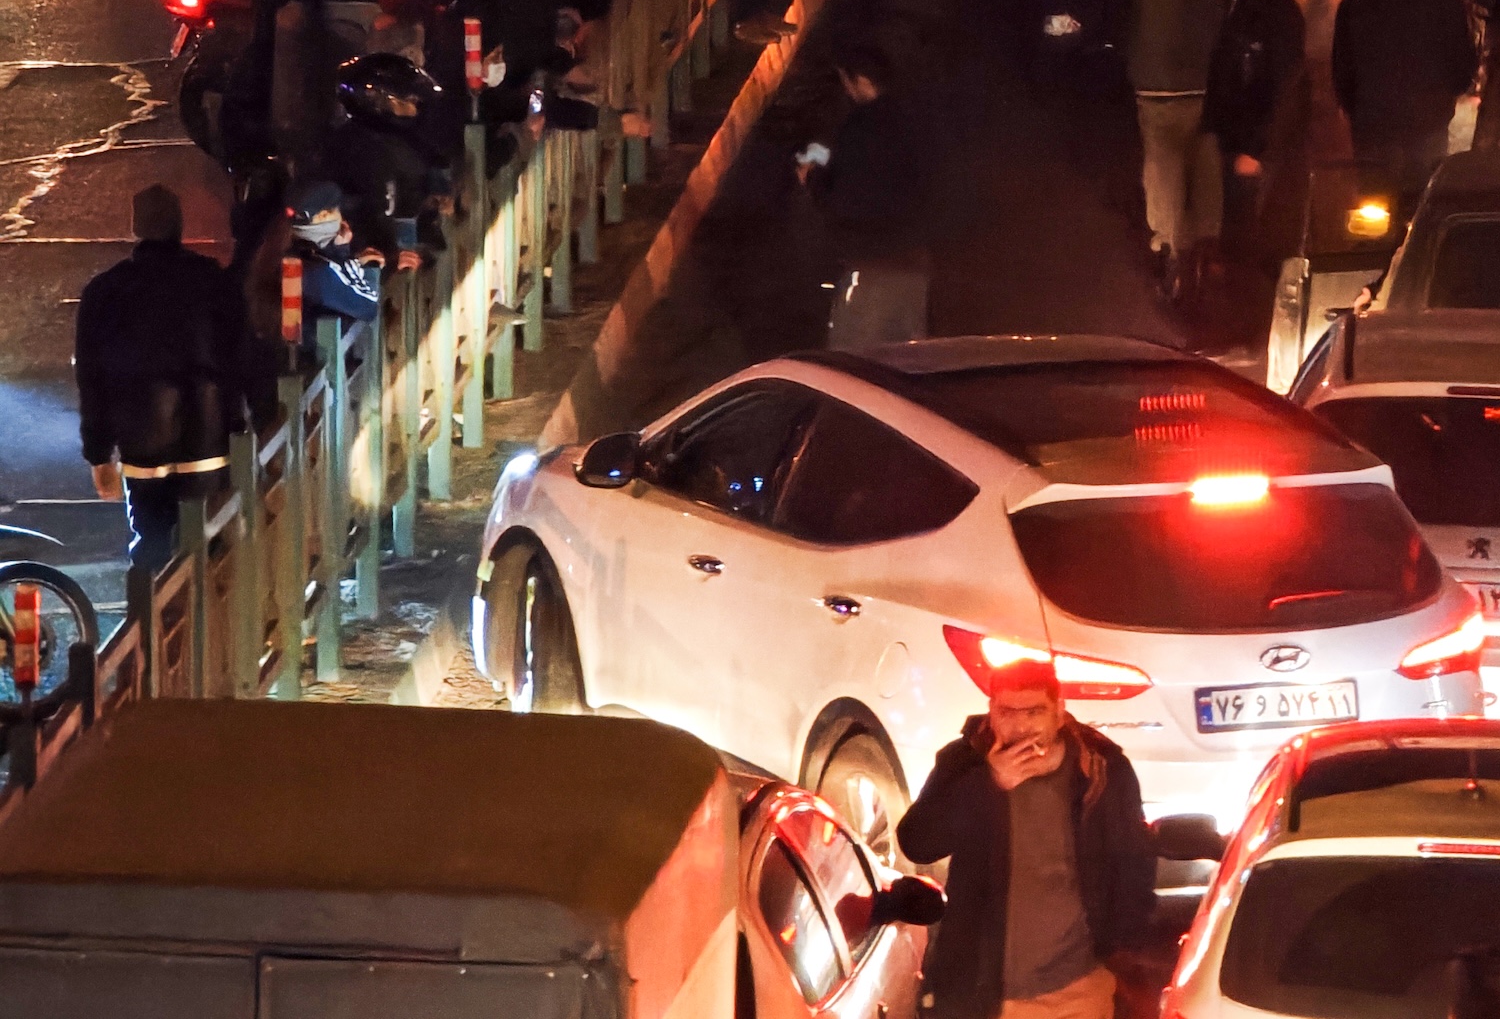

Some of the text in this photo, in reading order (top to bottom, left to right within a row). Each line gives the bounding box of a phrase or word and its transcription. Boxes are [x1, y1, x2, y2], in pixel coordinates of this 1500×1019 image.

[1215, 695, 1245, 722] ۷۶
[1277, 691, 1320, 718] ۵۷۴
[1327, 693, 1352, 717] ۱۱
